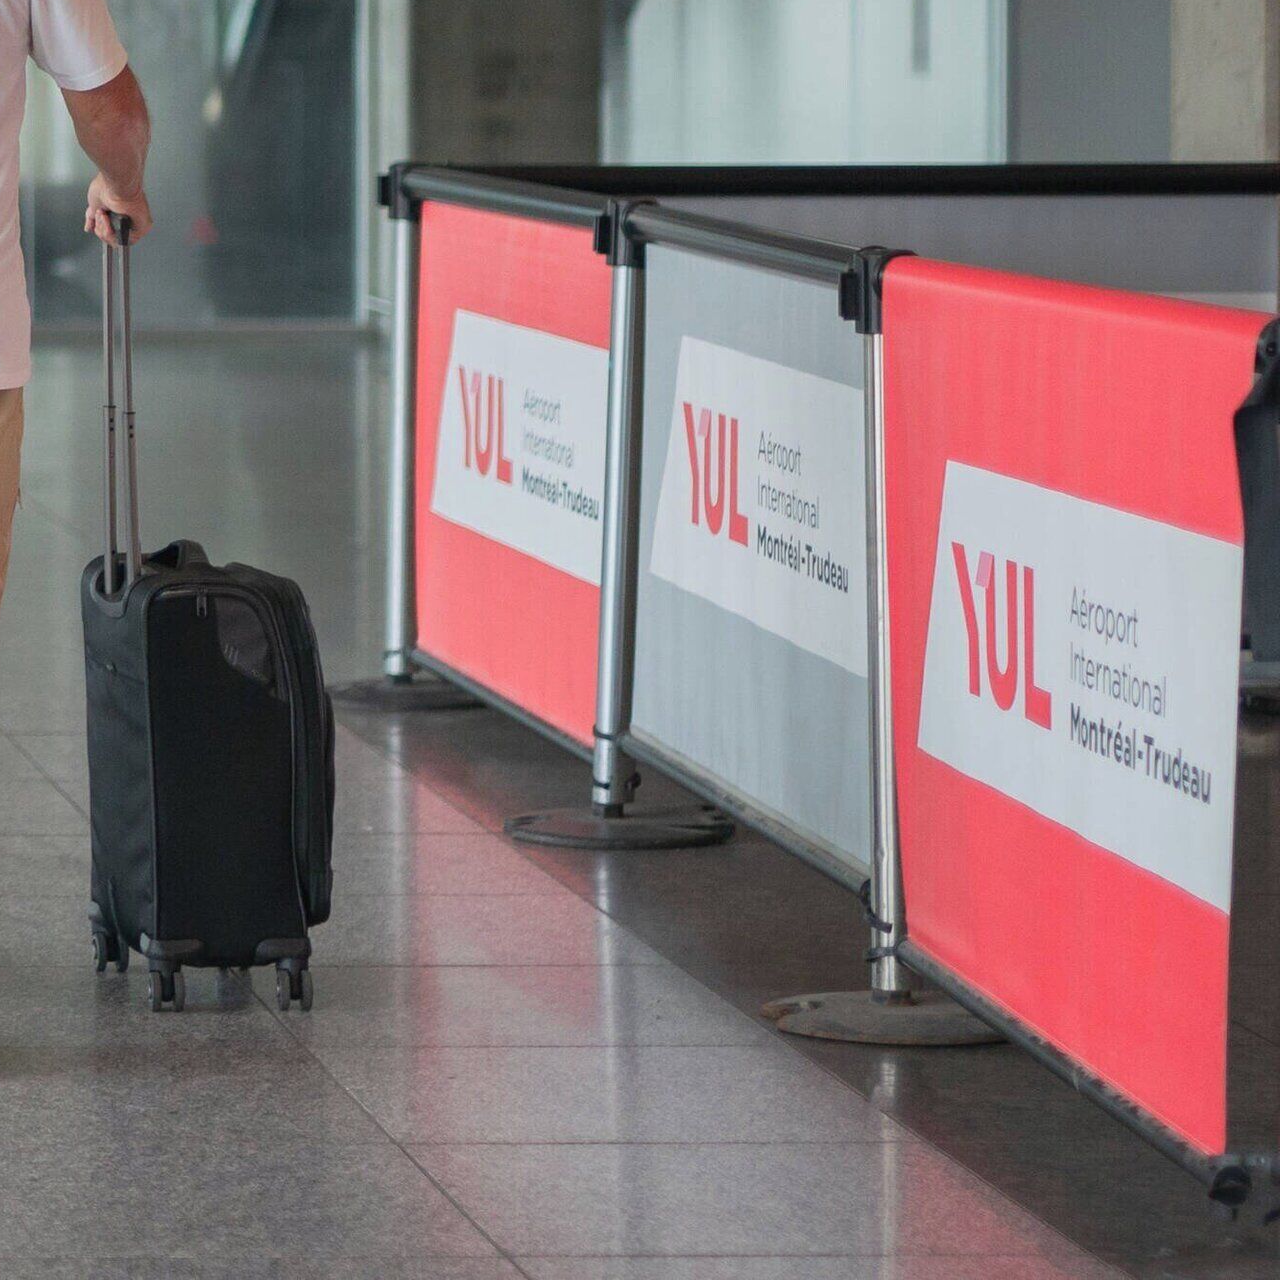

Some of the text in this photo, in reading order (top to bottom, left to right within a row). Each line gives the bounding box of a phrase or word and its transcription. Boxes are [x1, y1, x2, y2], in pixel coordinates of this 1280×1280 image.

[458, 365, 512, 486] YUL
[758, 431, 802, 476] Aéroport
[521, 465, 600, 521] Montréal-Trudeau
[683, 401, 748, 547] YUL
[757, 475, 820, 529] International
[757, 524, 850, 594] Montréal-Trudeau
[952, 541, 1052, 731] YUL
[1069, 586, 1140, 648] Aéroport
[1069, 641, 1167, 719] International
[1070, 702, 1211, 805] Montréal-Trudeau
